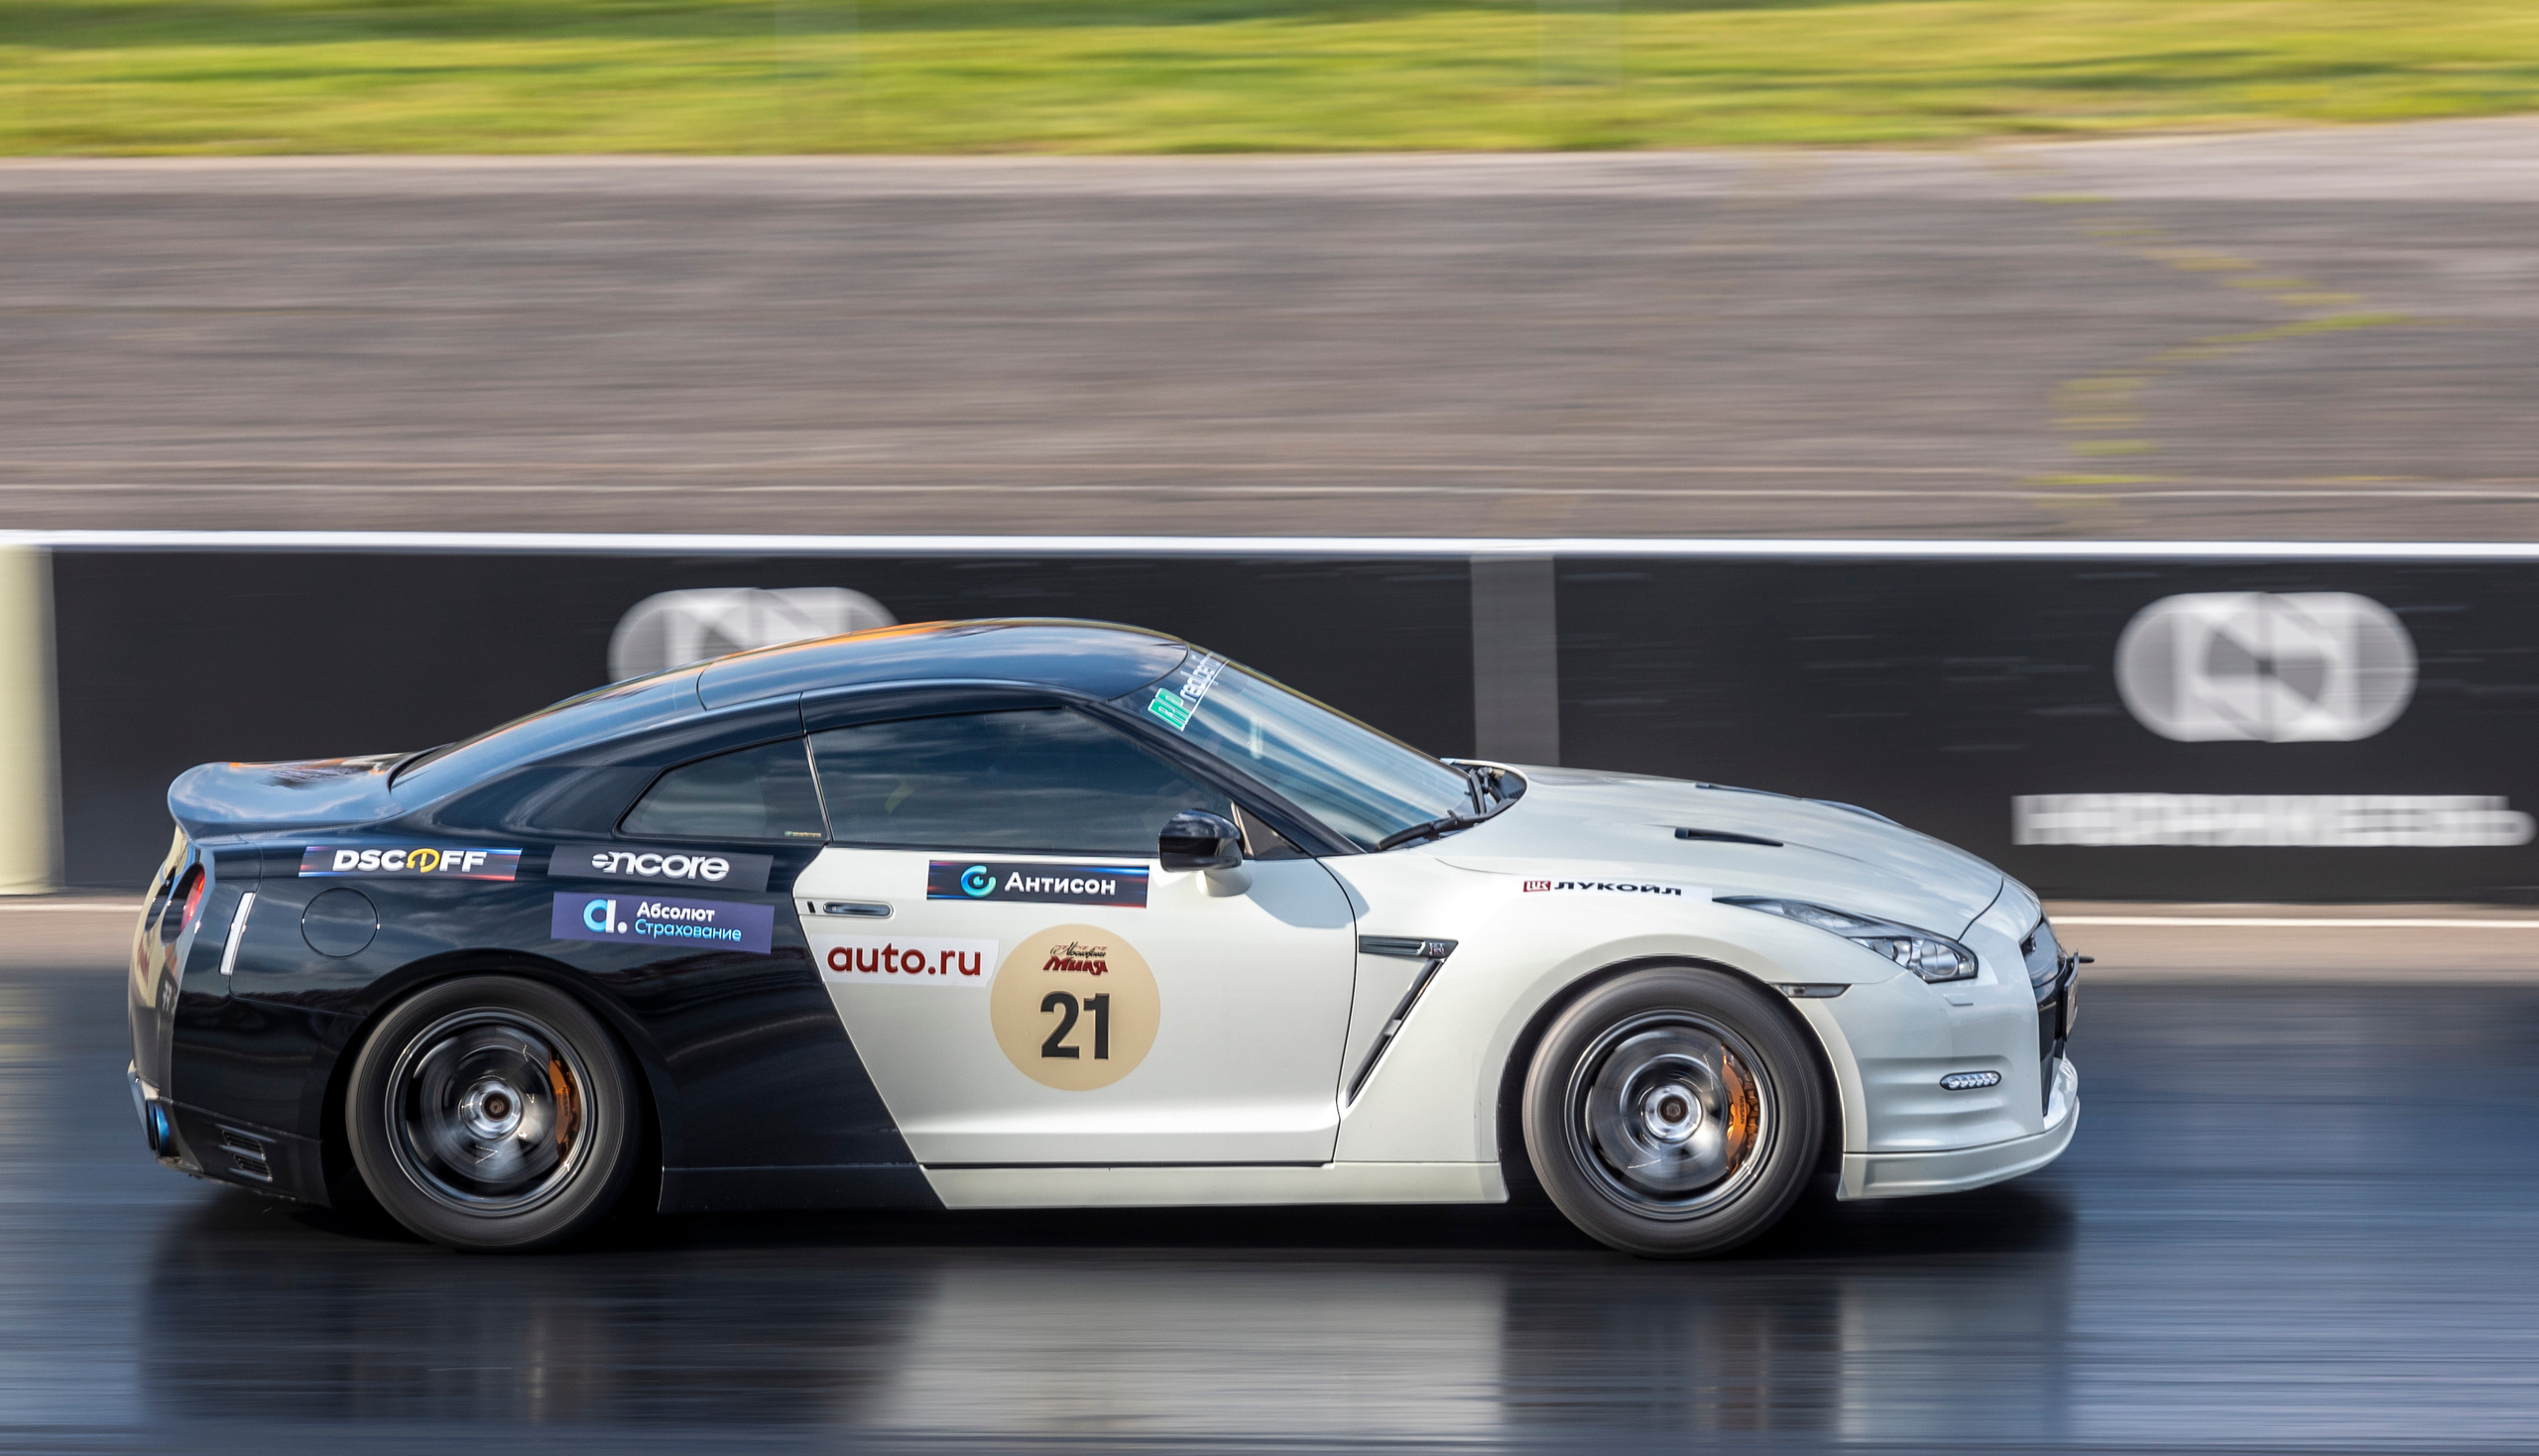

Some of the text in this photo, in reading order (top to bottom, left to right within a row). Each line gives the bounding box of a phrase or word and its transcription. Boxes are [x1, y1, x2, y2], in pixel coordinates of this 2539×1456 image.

[591, 850, 730, 882] encore
[1004, 871, 1117, 897] Антисон
[1554, 881, 1682, 897] ЛУКОЙЛ
[636, 902, 716, 923] Абсолют
[634, 918, 743, 942] Страхование
[826, 941, 981, 976] auto.ru
[1042, 955, 1109, 976] Миля
[1039, 990, 1110, 1061] 21
